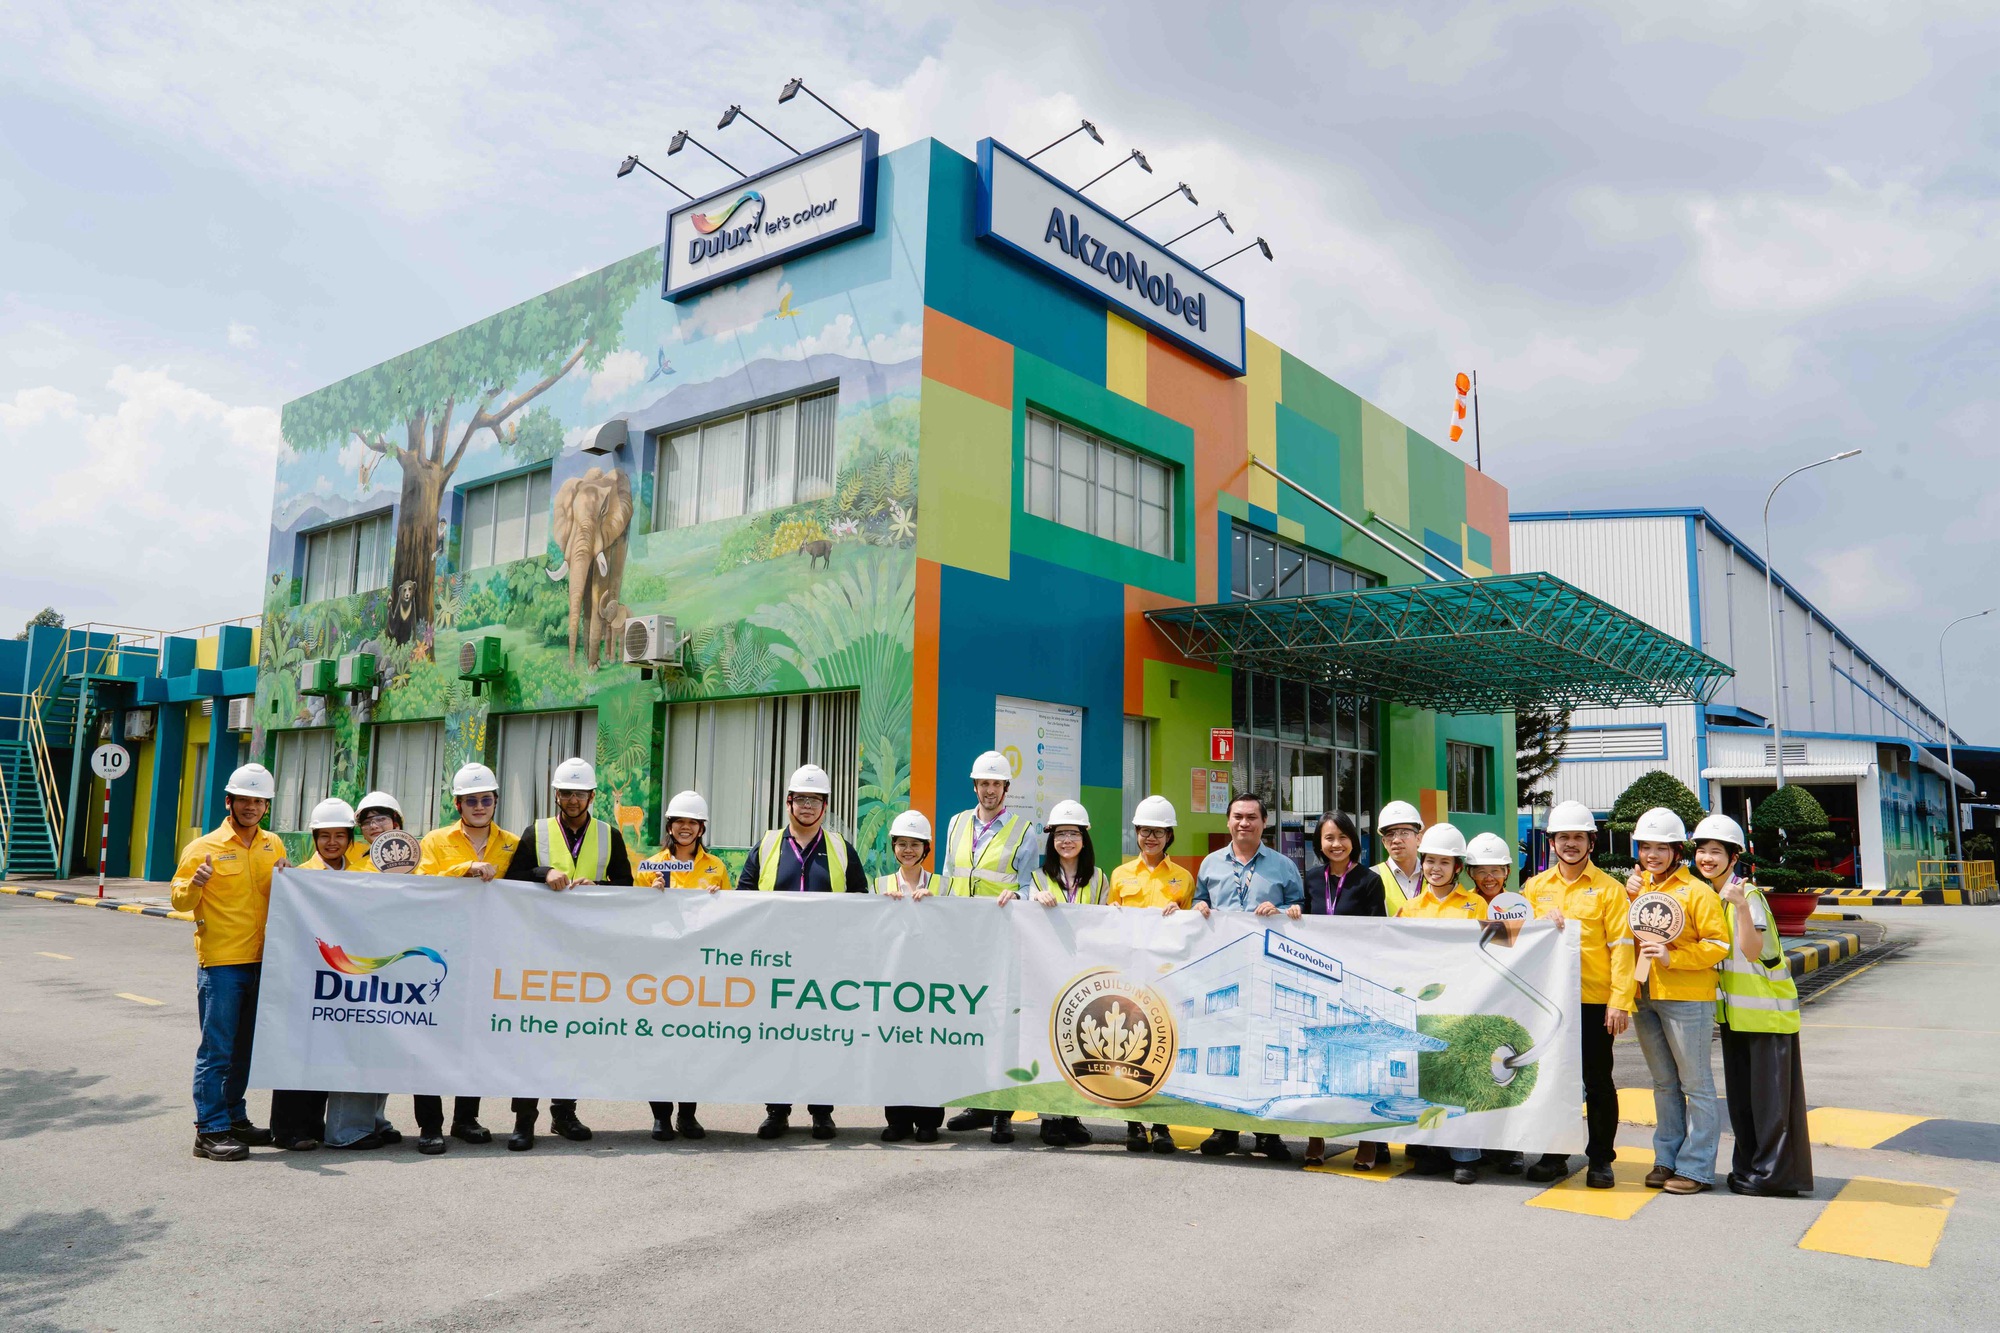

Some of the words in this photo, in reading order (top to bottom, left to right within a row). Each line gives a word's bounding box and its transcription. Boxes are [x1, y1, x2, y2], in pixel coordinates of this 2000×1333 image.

[793, 198, 837, 225] colour
[688, 222, 752, 265] Dulux
[1044, 206, 1207, 333] AkzoNobel
[100, 752, 122, 767] 10
[639, 861, 693, 871] AkzoNobel
[1493, 911, 1524, 920] Dulux
[700, 947, 744, 966] The
[750, 948, 792, 968] first
[1278, 942, 1333, 972] AkzoNobel
[313, 969, 428, 1005] Dulux
[492, 967, 612, 1003] LEED
[625, 973, 756, 1008] GOLD
[770, 977, 990, 1015] FACTORY
[1093, 978, 1151, 1006] BUILDING
[311, 1006, 438, 1027] PROFESSIONAL
[1062, 986, 1092, 1026] GREEN
[490, 1013, 512, 1033] in
[519, 1014, 559, 1034] the
[565, 1017, 628, 1039] paint
[634, 1018, 654, 1037] &
[661, 1020, 752, 1044] coating
[758, 1022, 855, 1047] industry
[877, 1025, 924, 1044] Viet
[930, 1027, 984, 1046] Nam
[1062, 1028, 1075, 1054] U.S.
[1150, 1006, 1167, 1065] COUNCIL
[1088, 1063, 1112, 1073] LEED
[1114, 1065, 1141, 1078] GOLD
